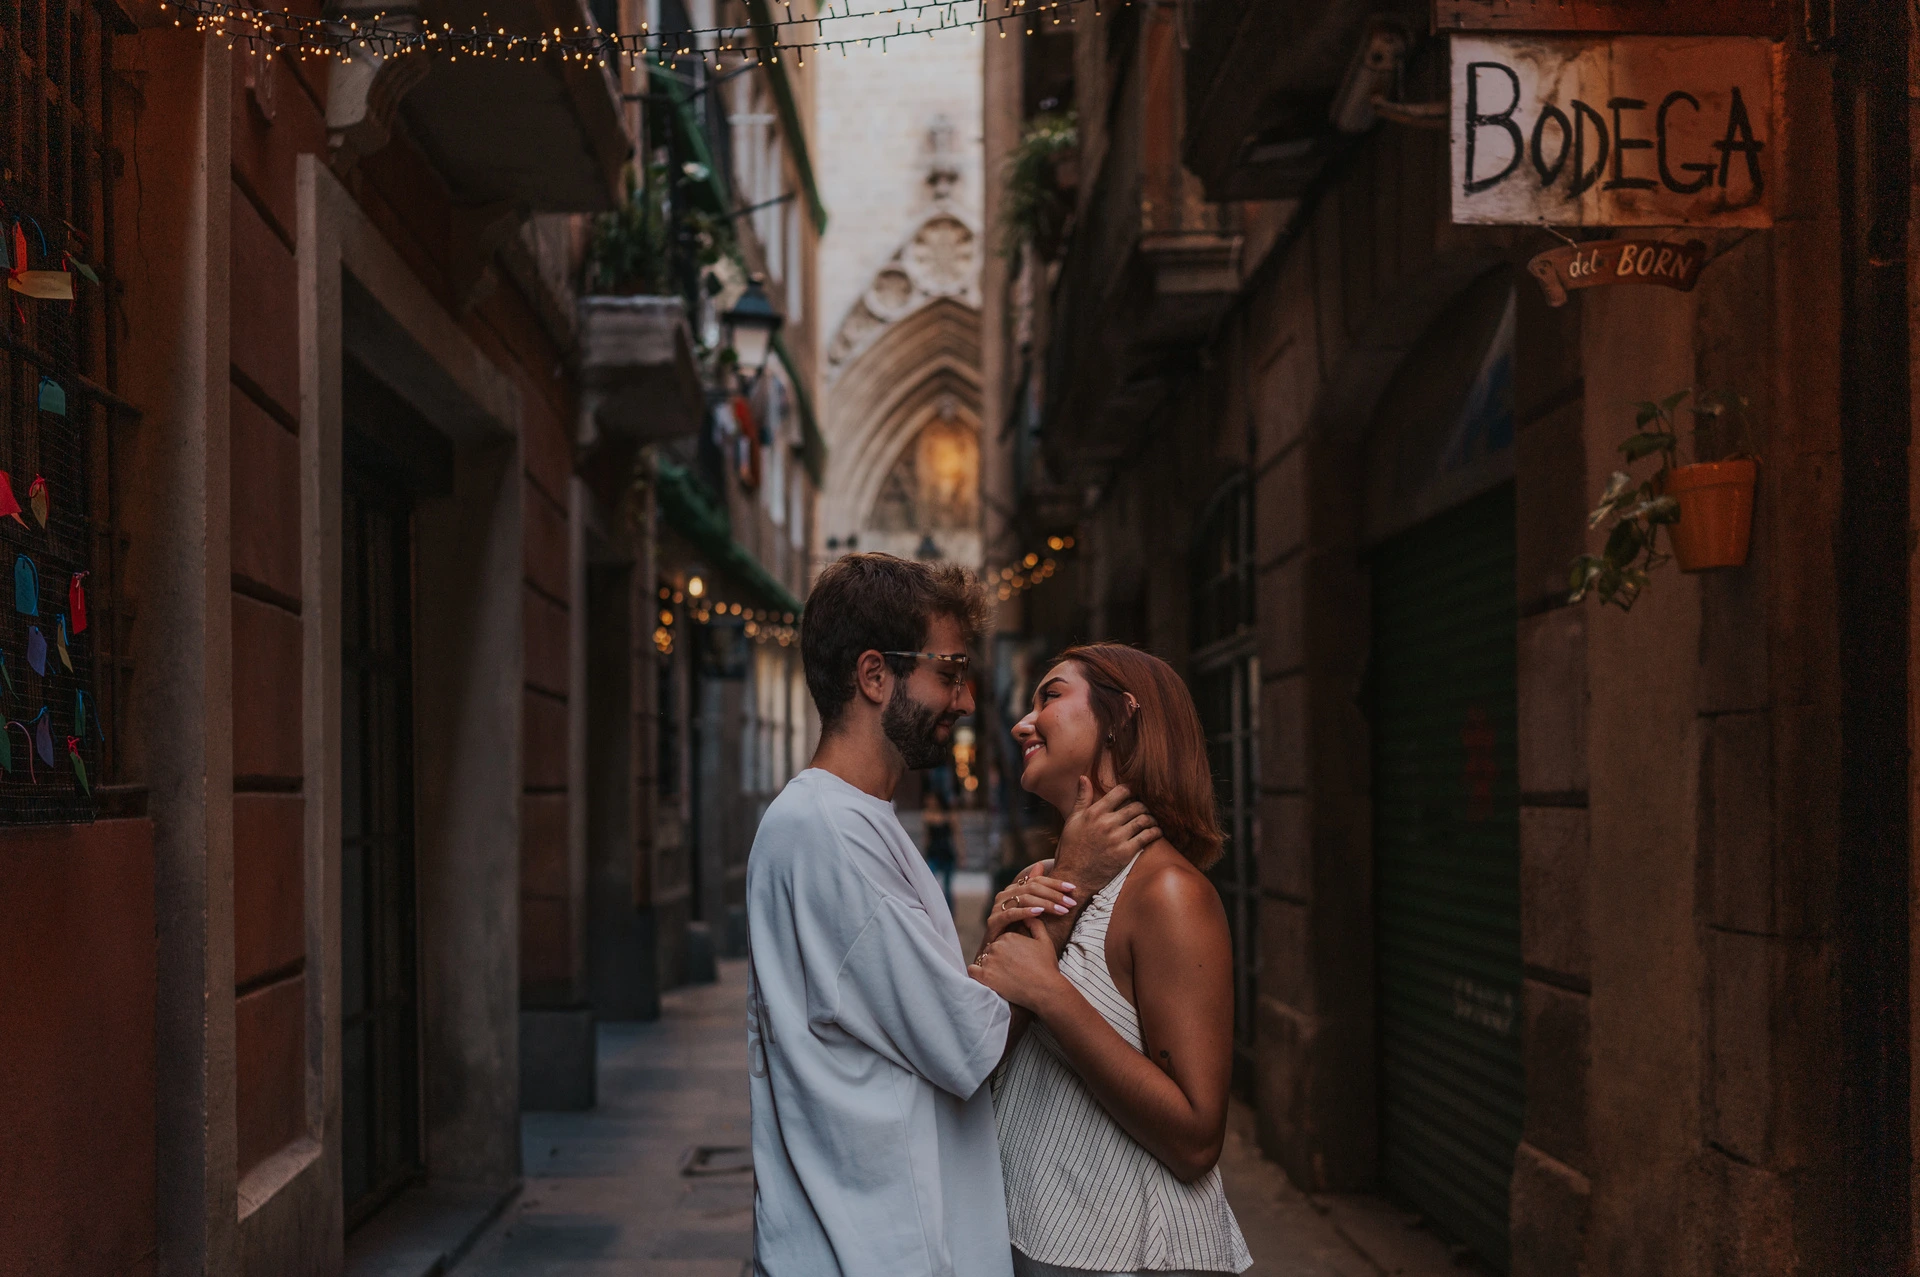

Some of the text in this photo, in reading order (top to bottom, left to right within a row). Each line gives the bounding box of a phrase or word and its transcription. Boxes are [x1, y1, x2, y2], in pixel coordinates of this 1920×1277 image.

[1464, 61, 1765, 200] BODEGA
[1569, 244, 1693, 280] del BORN
